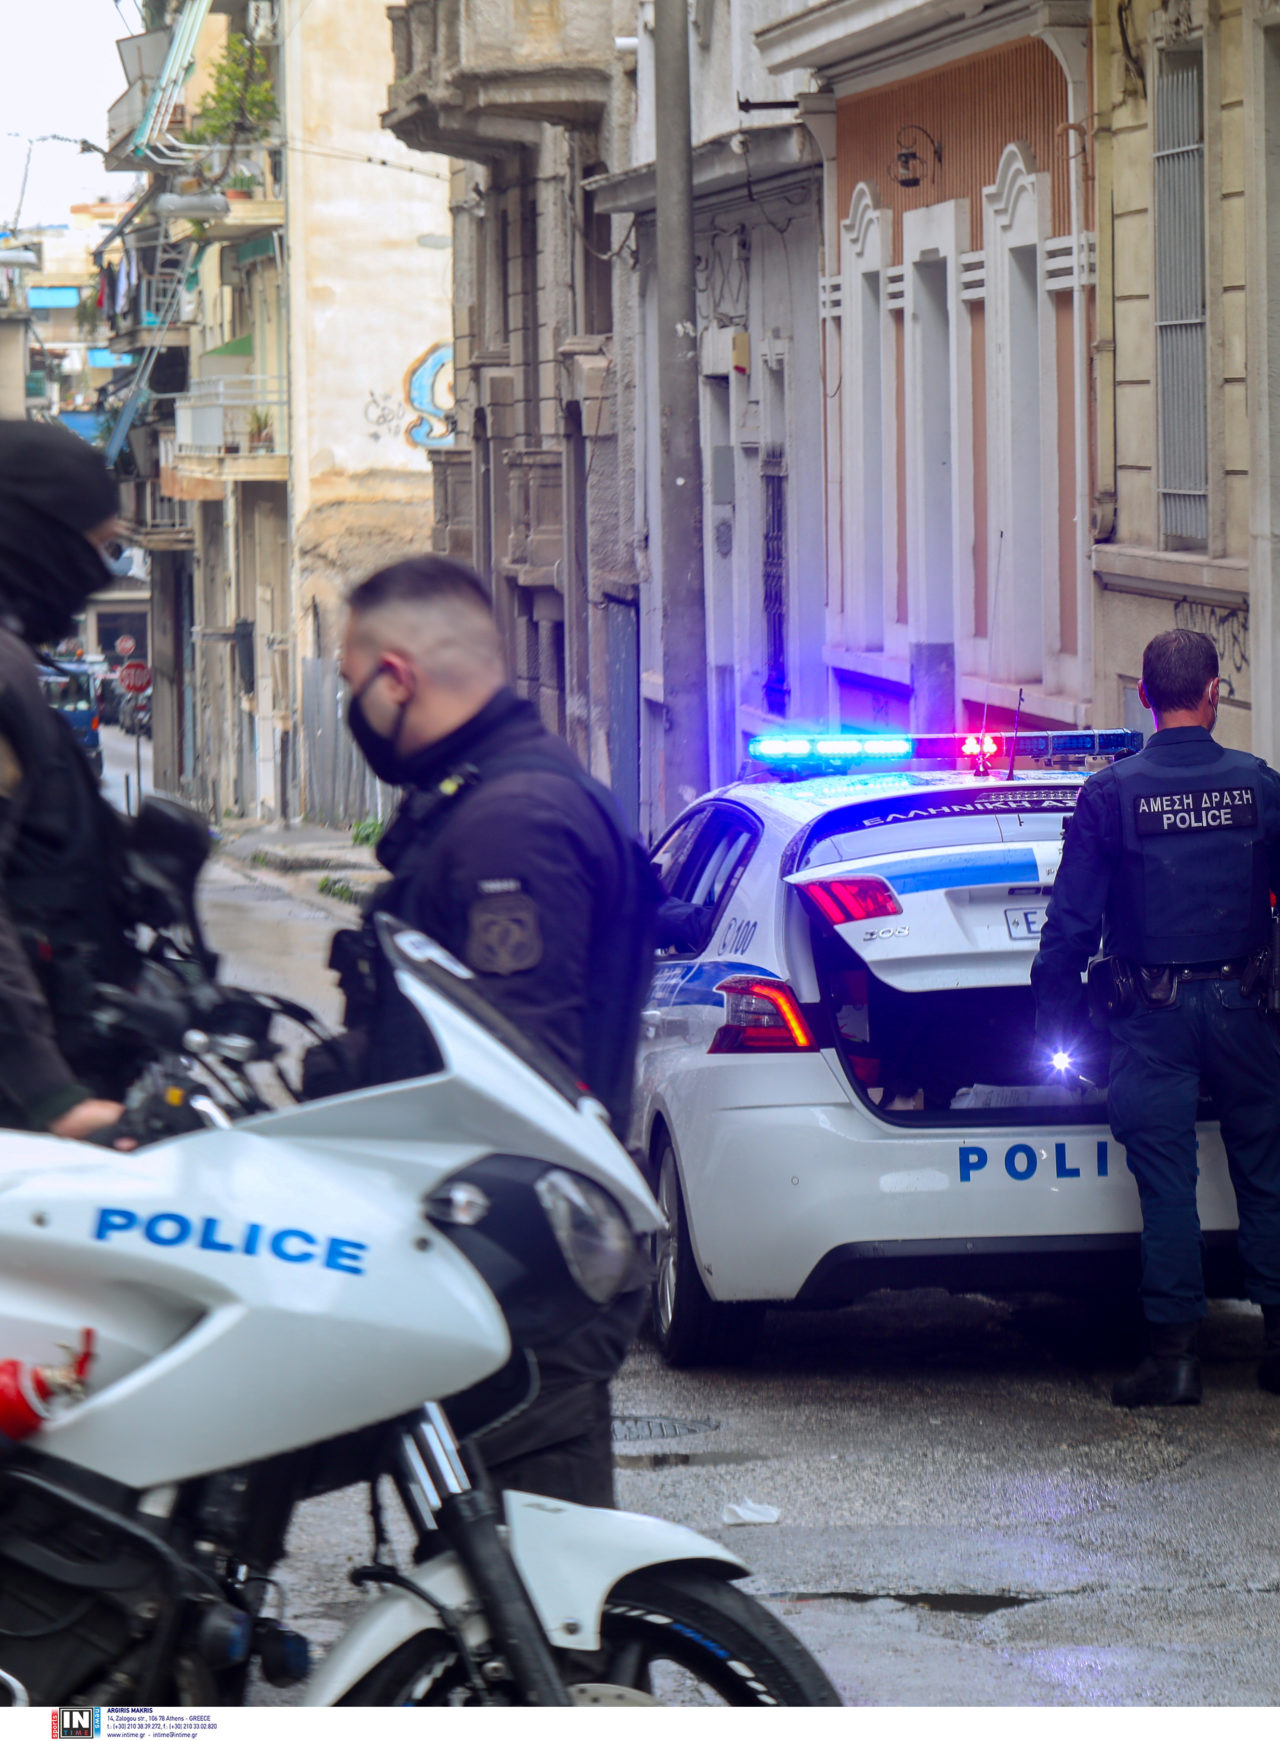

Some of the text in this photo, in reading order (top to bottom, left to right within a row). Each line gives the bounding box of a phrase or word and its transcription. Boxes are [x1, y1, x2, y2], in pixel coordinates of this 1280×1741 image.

[863, 800, 1030, 827] ΕΛΛΗΝΙΚΗ
[1139, 789, 1252, 813] ΑΜΕΣΗ ΔΡΑΣΗ
[1162, 809, 1232, 830] POLICE
[729, 919, 758, 956] 100
[93, 1207, 368, 1275] POLICE
